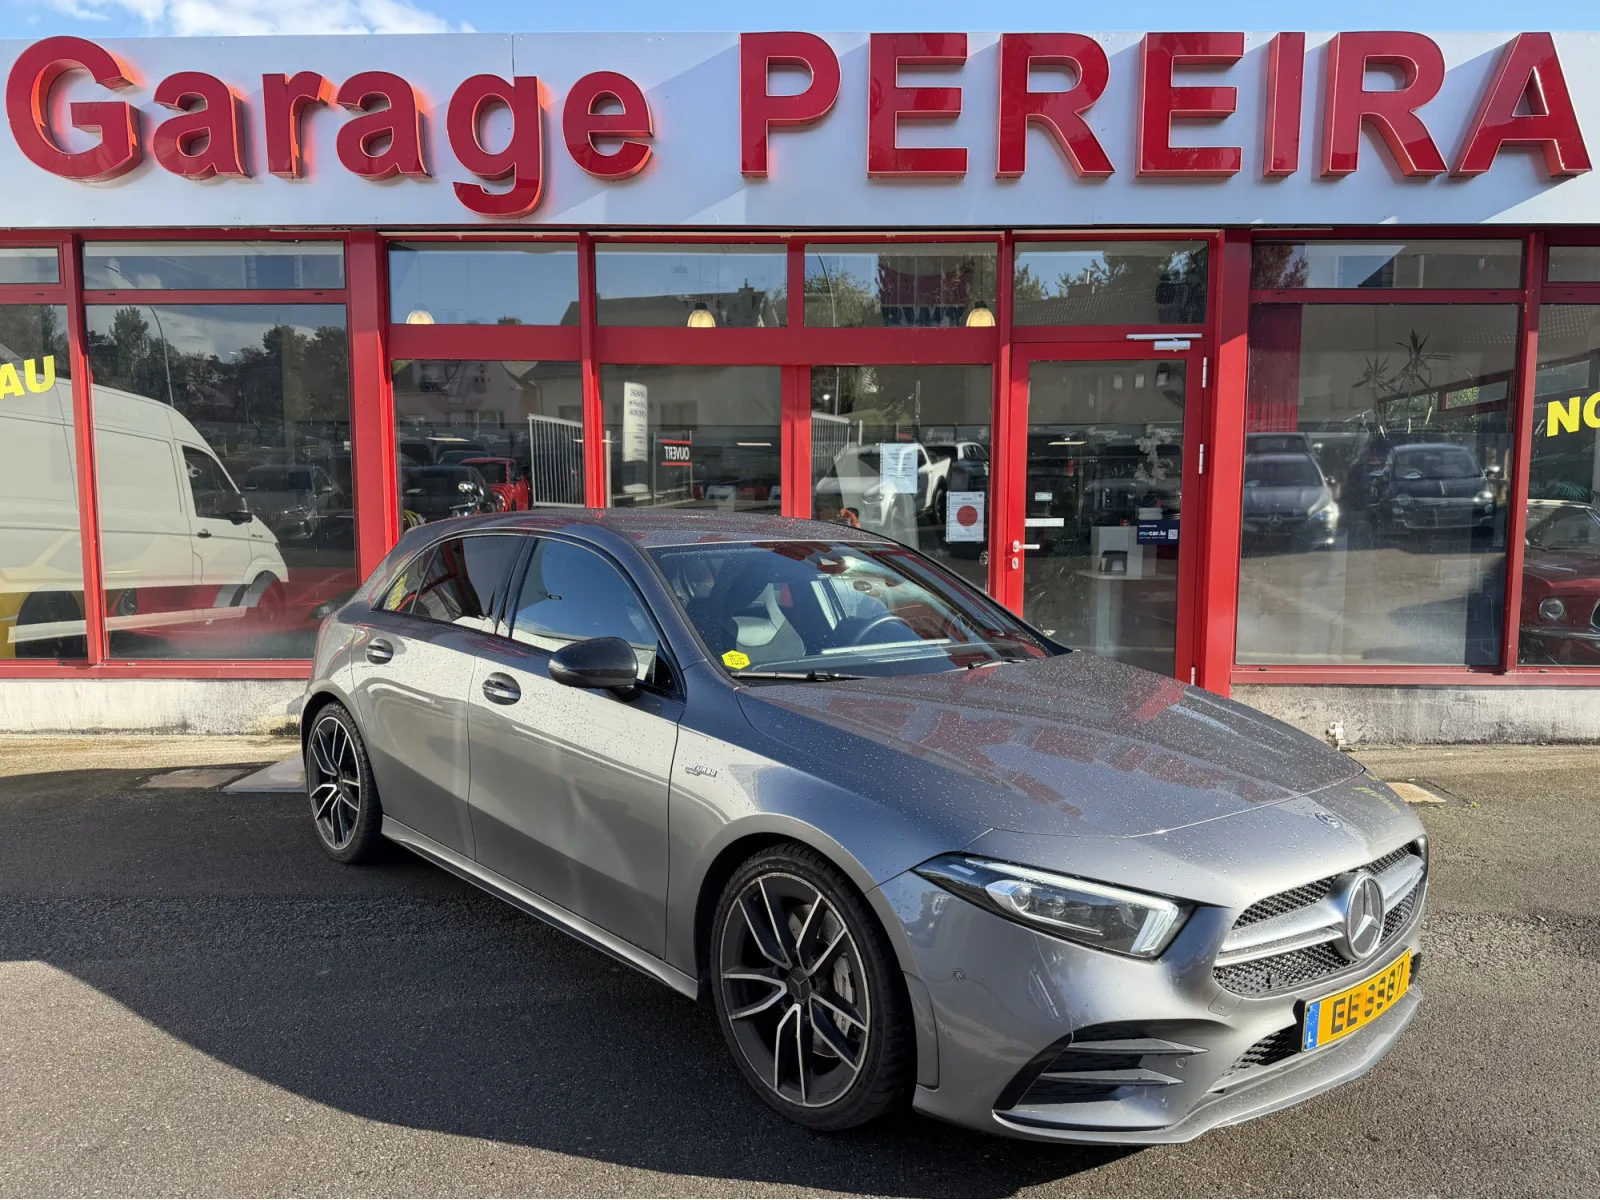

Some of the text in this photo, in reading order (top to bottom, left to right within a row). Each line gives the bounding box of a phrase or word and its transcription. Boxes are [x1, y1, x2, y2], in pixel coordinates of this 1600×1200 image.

[5, 31, 1593, 218] Garage PEREIRA
[1307, 1031, 1314, 1043] L
